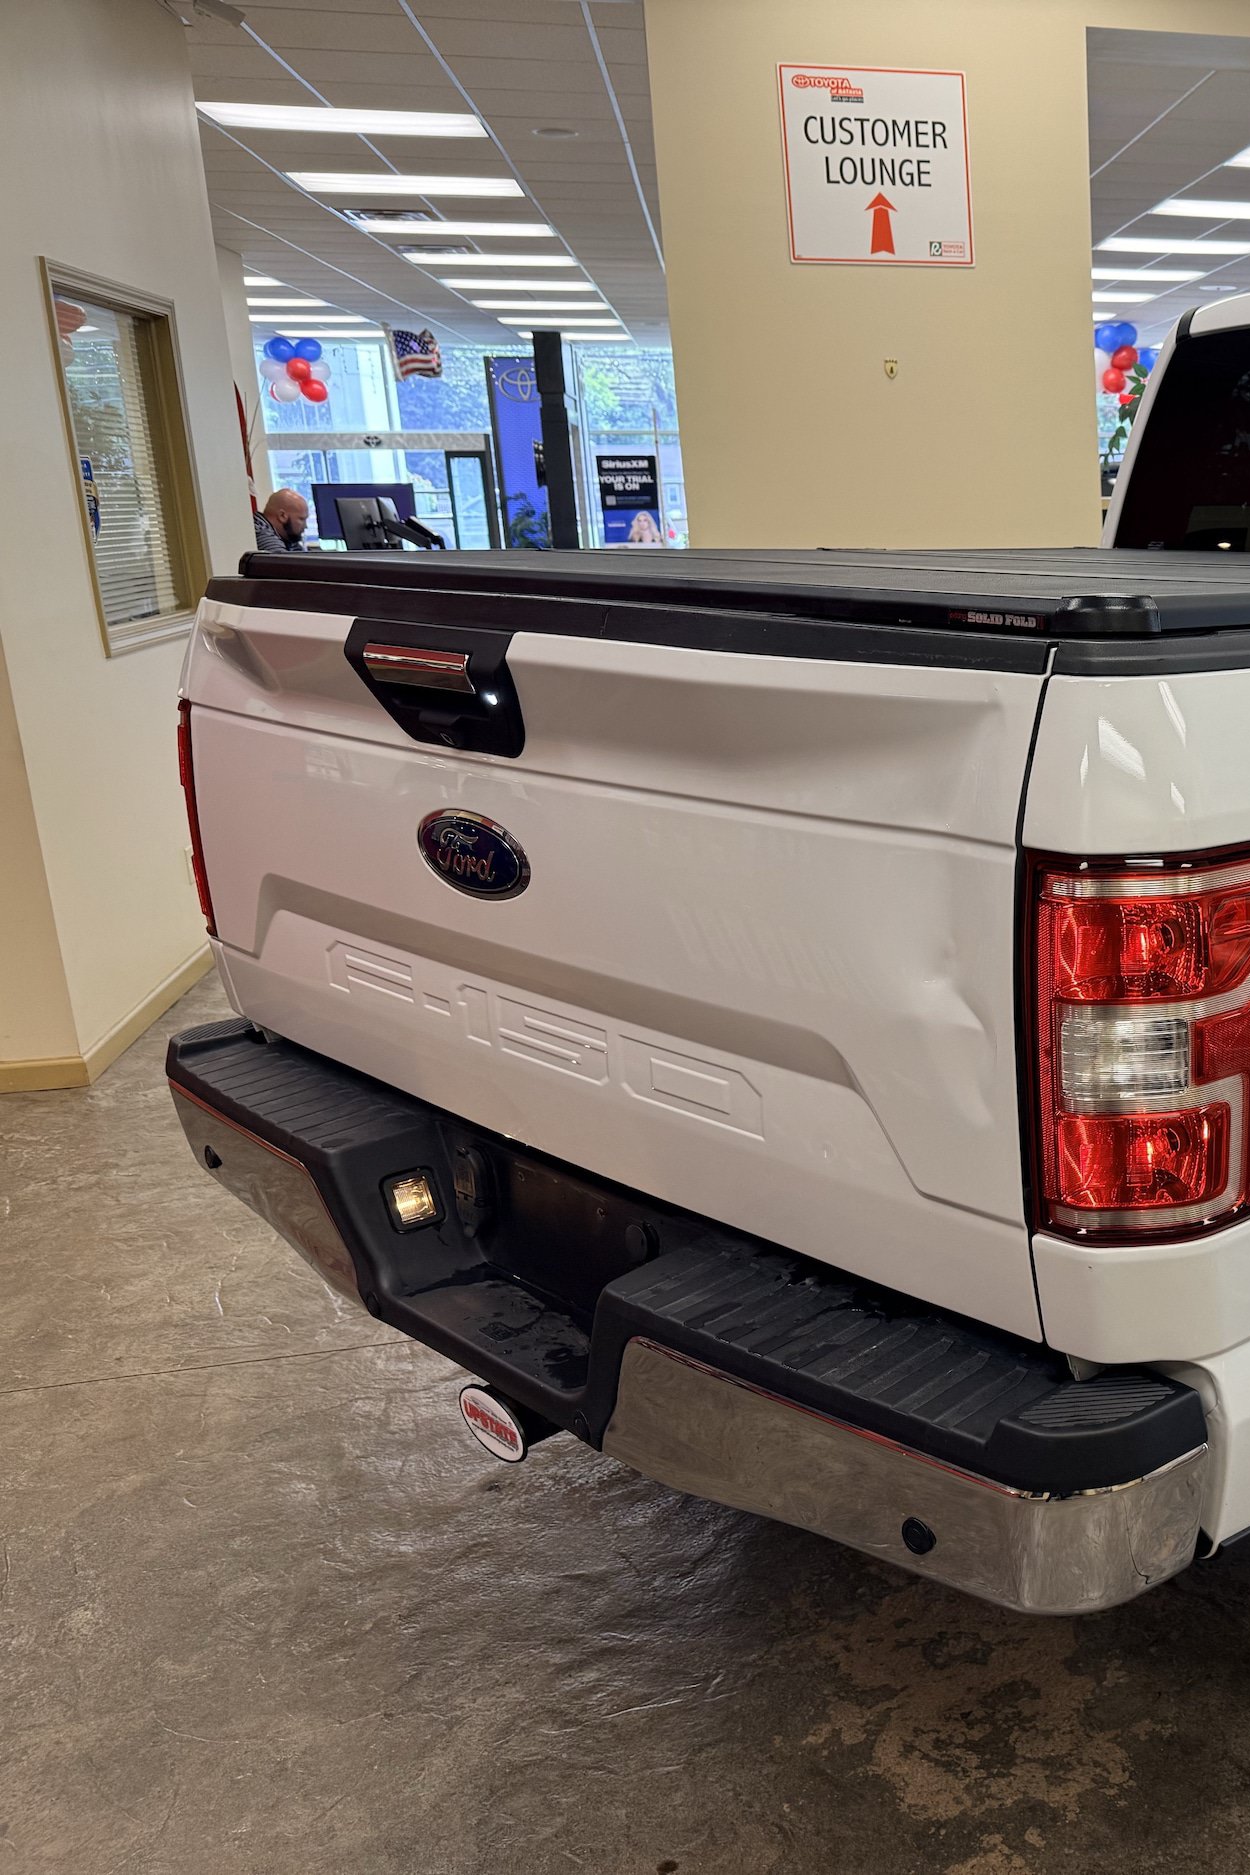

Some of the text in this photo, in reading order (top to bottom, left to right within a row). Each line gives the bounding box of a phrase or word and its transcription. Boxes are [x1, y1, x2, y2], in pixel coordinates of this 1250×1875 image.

[808, 77, 850, 88] TOYOTA
[803, 115, 948, 149] CUSTOMER
[824, 155, 932, 187] LOUNGE
[602, 460, 648, 469] SiriusXM
[600, 475, 654, 484] YOUR TRIAL
[967, 611, 1003, 625] SOLID
[1004, 614, 1037, 628] FOLD
[435, 827, 496, 883] Ford
[325, 939, 766, 1142] F-150
